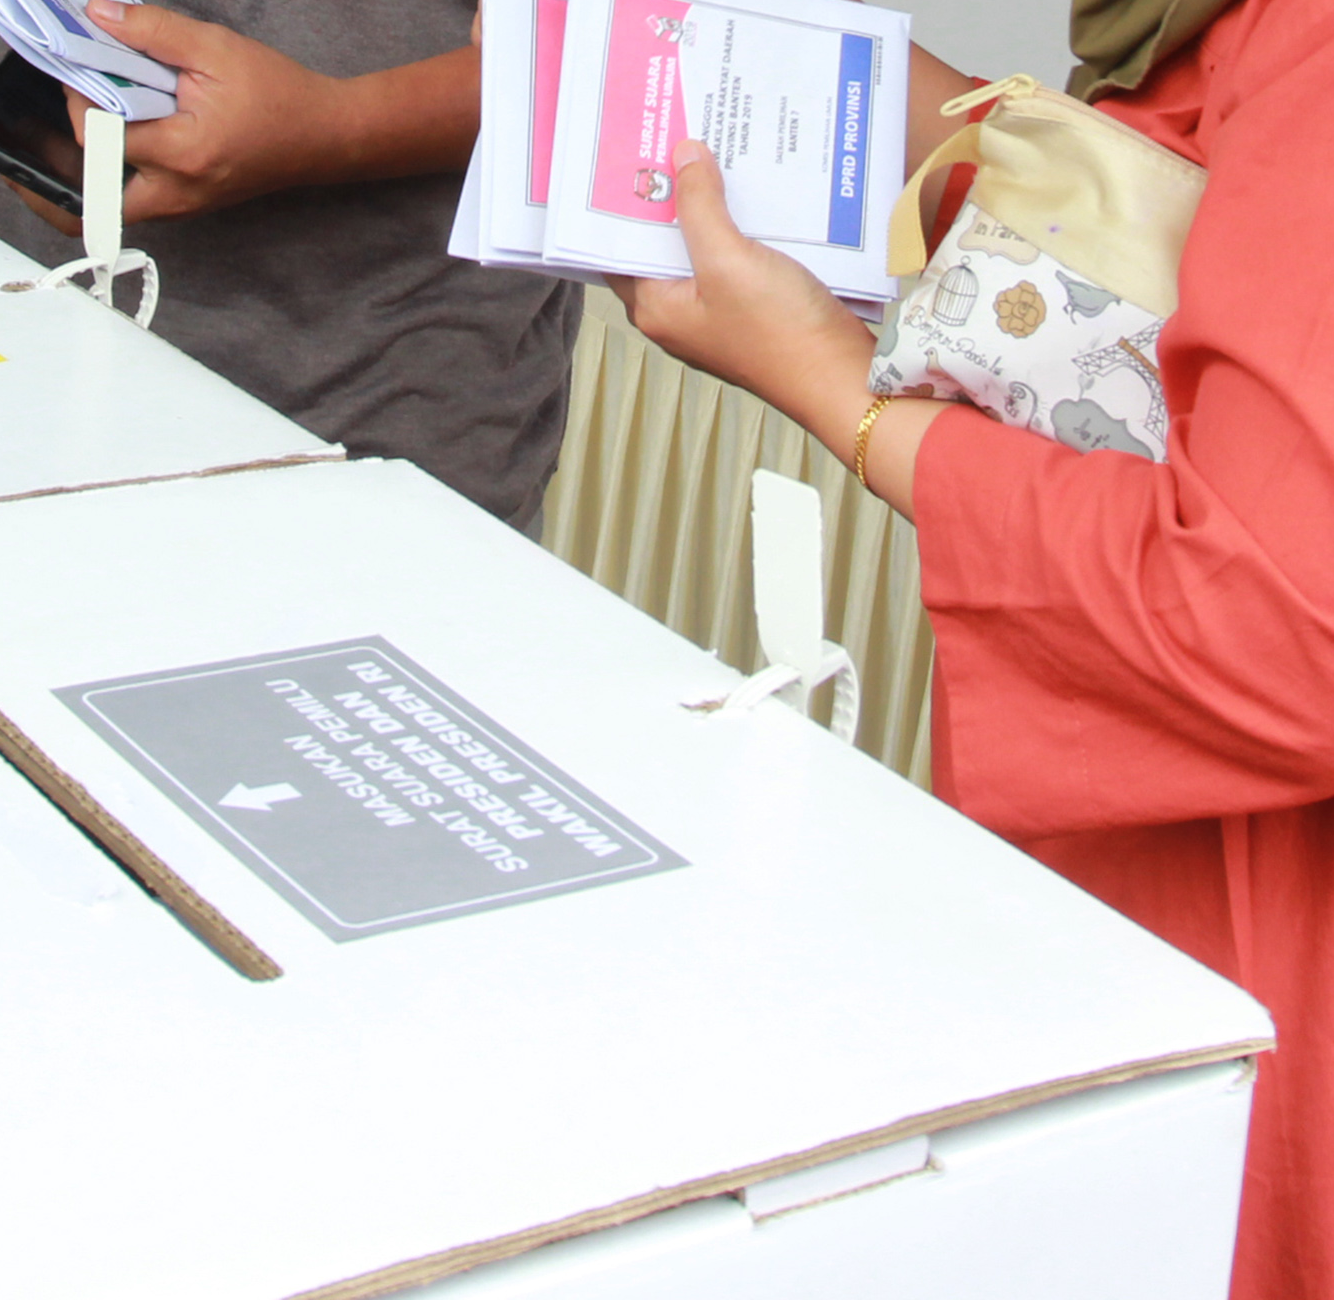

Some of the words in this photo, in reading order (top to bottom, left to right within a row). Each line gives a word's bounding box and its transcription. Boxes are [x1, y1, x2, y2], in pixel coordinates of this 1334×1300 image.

[722, 19, 736, 63] DAERAH
[644, 55, 662, 108] SUARA
[662, 56, 677, 97] UMUM
[717, 65, 730, 108] RAKYAT
[729, 76, 742, 119] BANTEN
[655, 98, 673, 164] PEMILIHAN
[700, 92, 714, 145] ANGGOTA
[742, 94, 753, 119] 2019
[843, 81, 862, 152] PROVINSI
[639, 109, 656, 159] SURAT
[712, 111, 726, 165] WAKILAN
[725, 121, 737, 170] PROVINSI
[739, 121, 750, 156] TAHUN
[788, 117, 799, 153] BANTEN
[840, 155, 857, 198] DPRD
[347, 661, 393, 684] RI
[264, 678, 364, 744] PEMILU
[332, 690, 406, 735] DAN
[376, 685, 526, 784] PRESIDEN
[282, 733, 417, 827] MASUKAN
[350, 741, 445, 808] SUARA
[389, 734, 545, 841] PRESIDEN
[428, 810, 530, 873] SURAT
[518, 784, 623, 858] WAKIL
